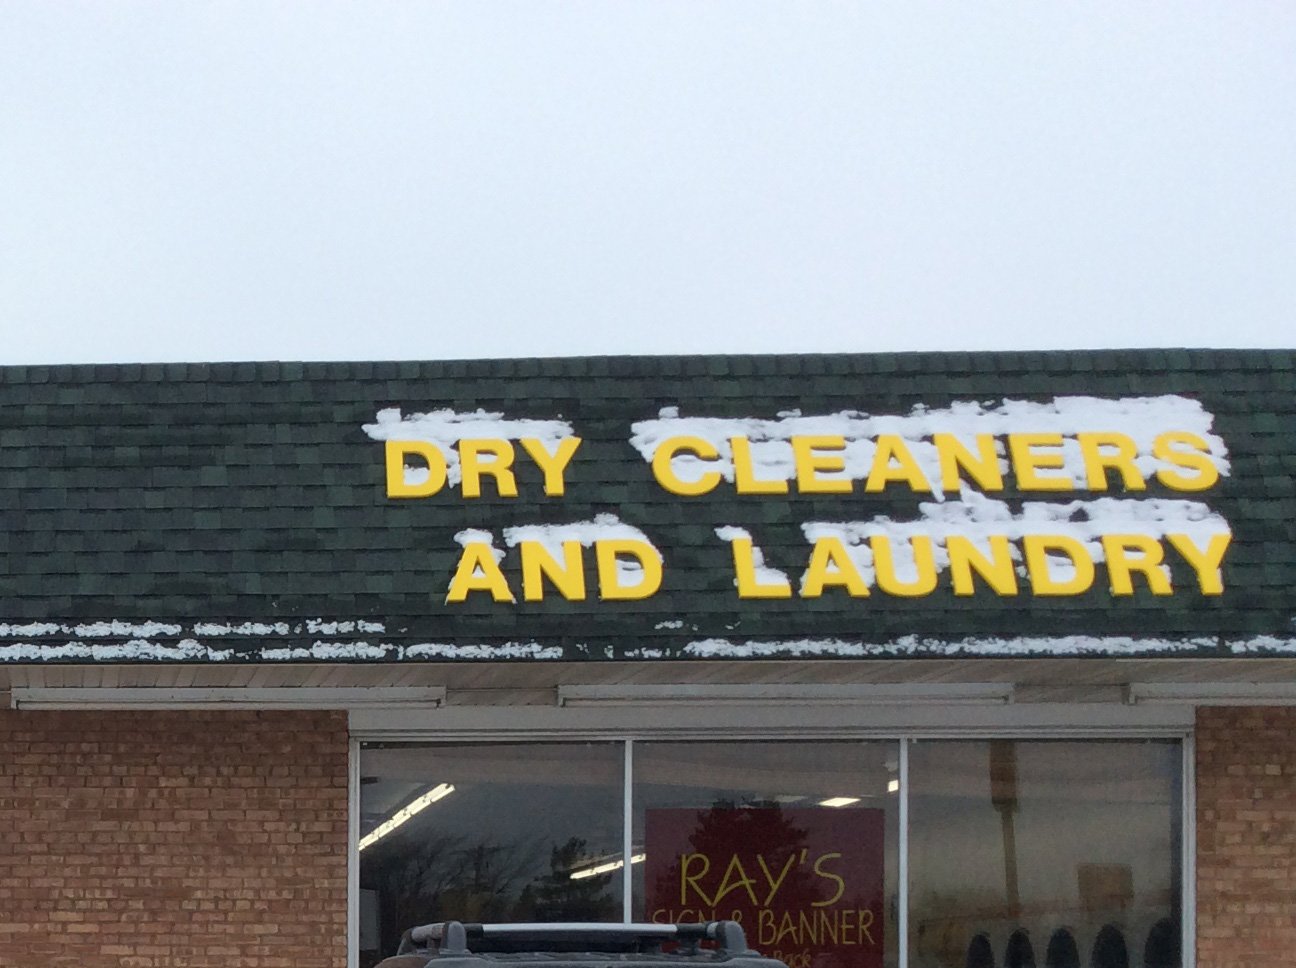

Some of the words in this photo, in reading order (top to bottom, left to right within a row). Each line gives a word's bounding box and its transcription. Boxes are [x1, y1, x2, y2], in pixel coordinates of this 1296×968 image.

[385, 436, 582, 498] DRY
[651, 431, 1220, 496] CLEANERS
[446, 538, 664, 602] AND
[731, 533, 1232, 599] LAUNDRY
[680, 848, 846, 908] RAY'S
[758, 908, 875, 946] BANNER
